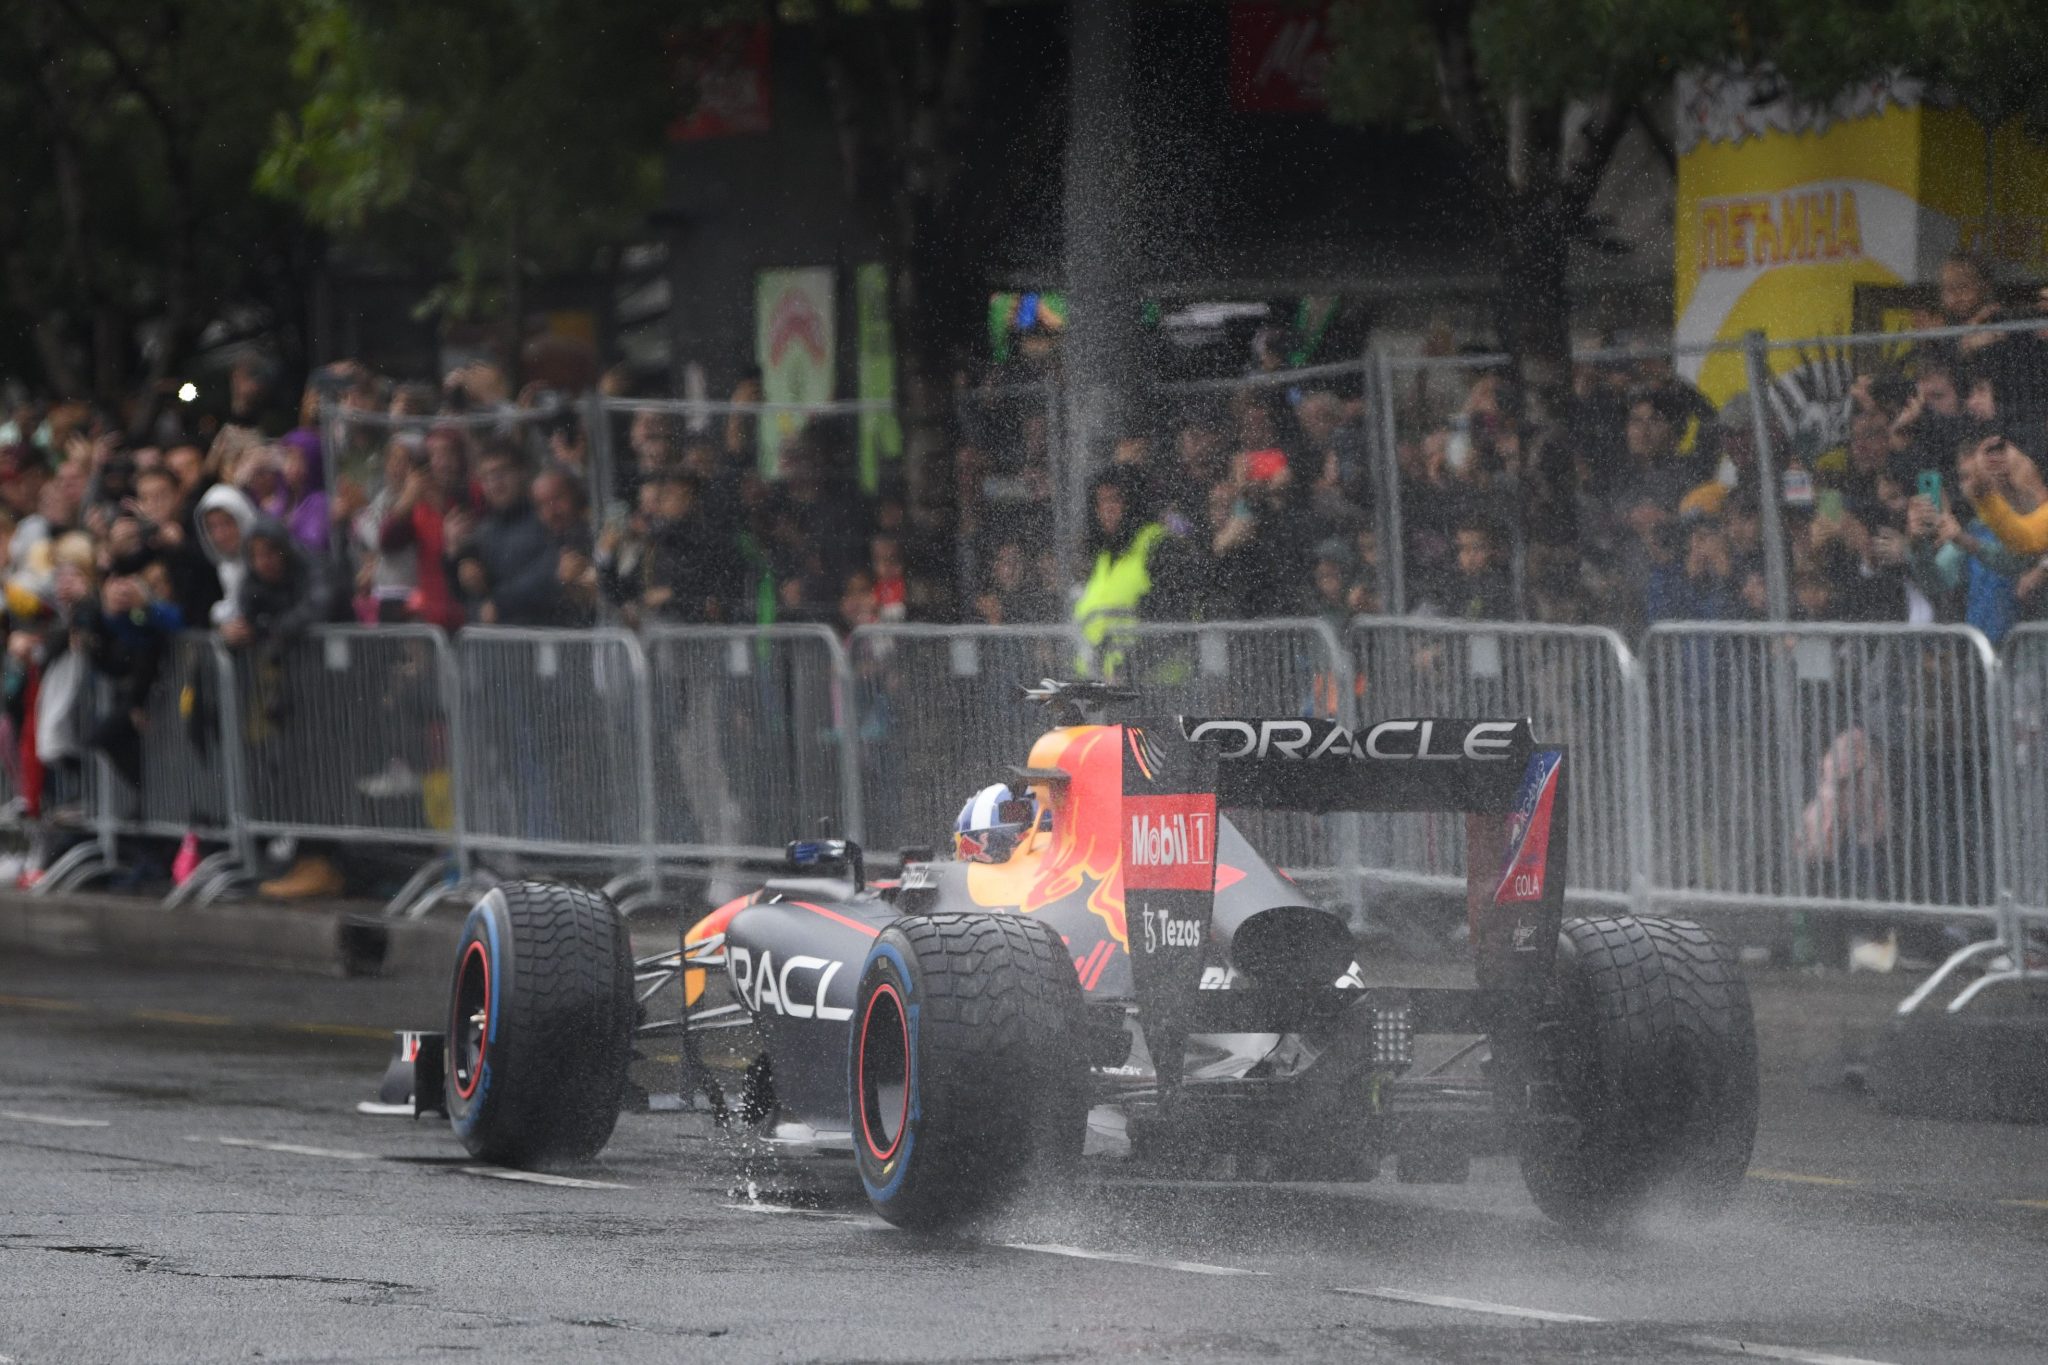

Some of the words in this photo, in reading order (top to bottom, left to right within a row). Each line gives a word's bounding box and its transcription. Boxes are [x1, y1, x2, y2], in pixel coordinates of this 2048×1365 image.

[1190, 720, 1517, 761] ORACLE
[1131, 814, 1188, 866] Mobil
[1194, 815, 1208, 862] 1
[1514, 874, 1540, 897] COLA
[1158, 909, 1201, 948] Tezos
[728, 946, 854, 1021] RACL
